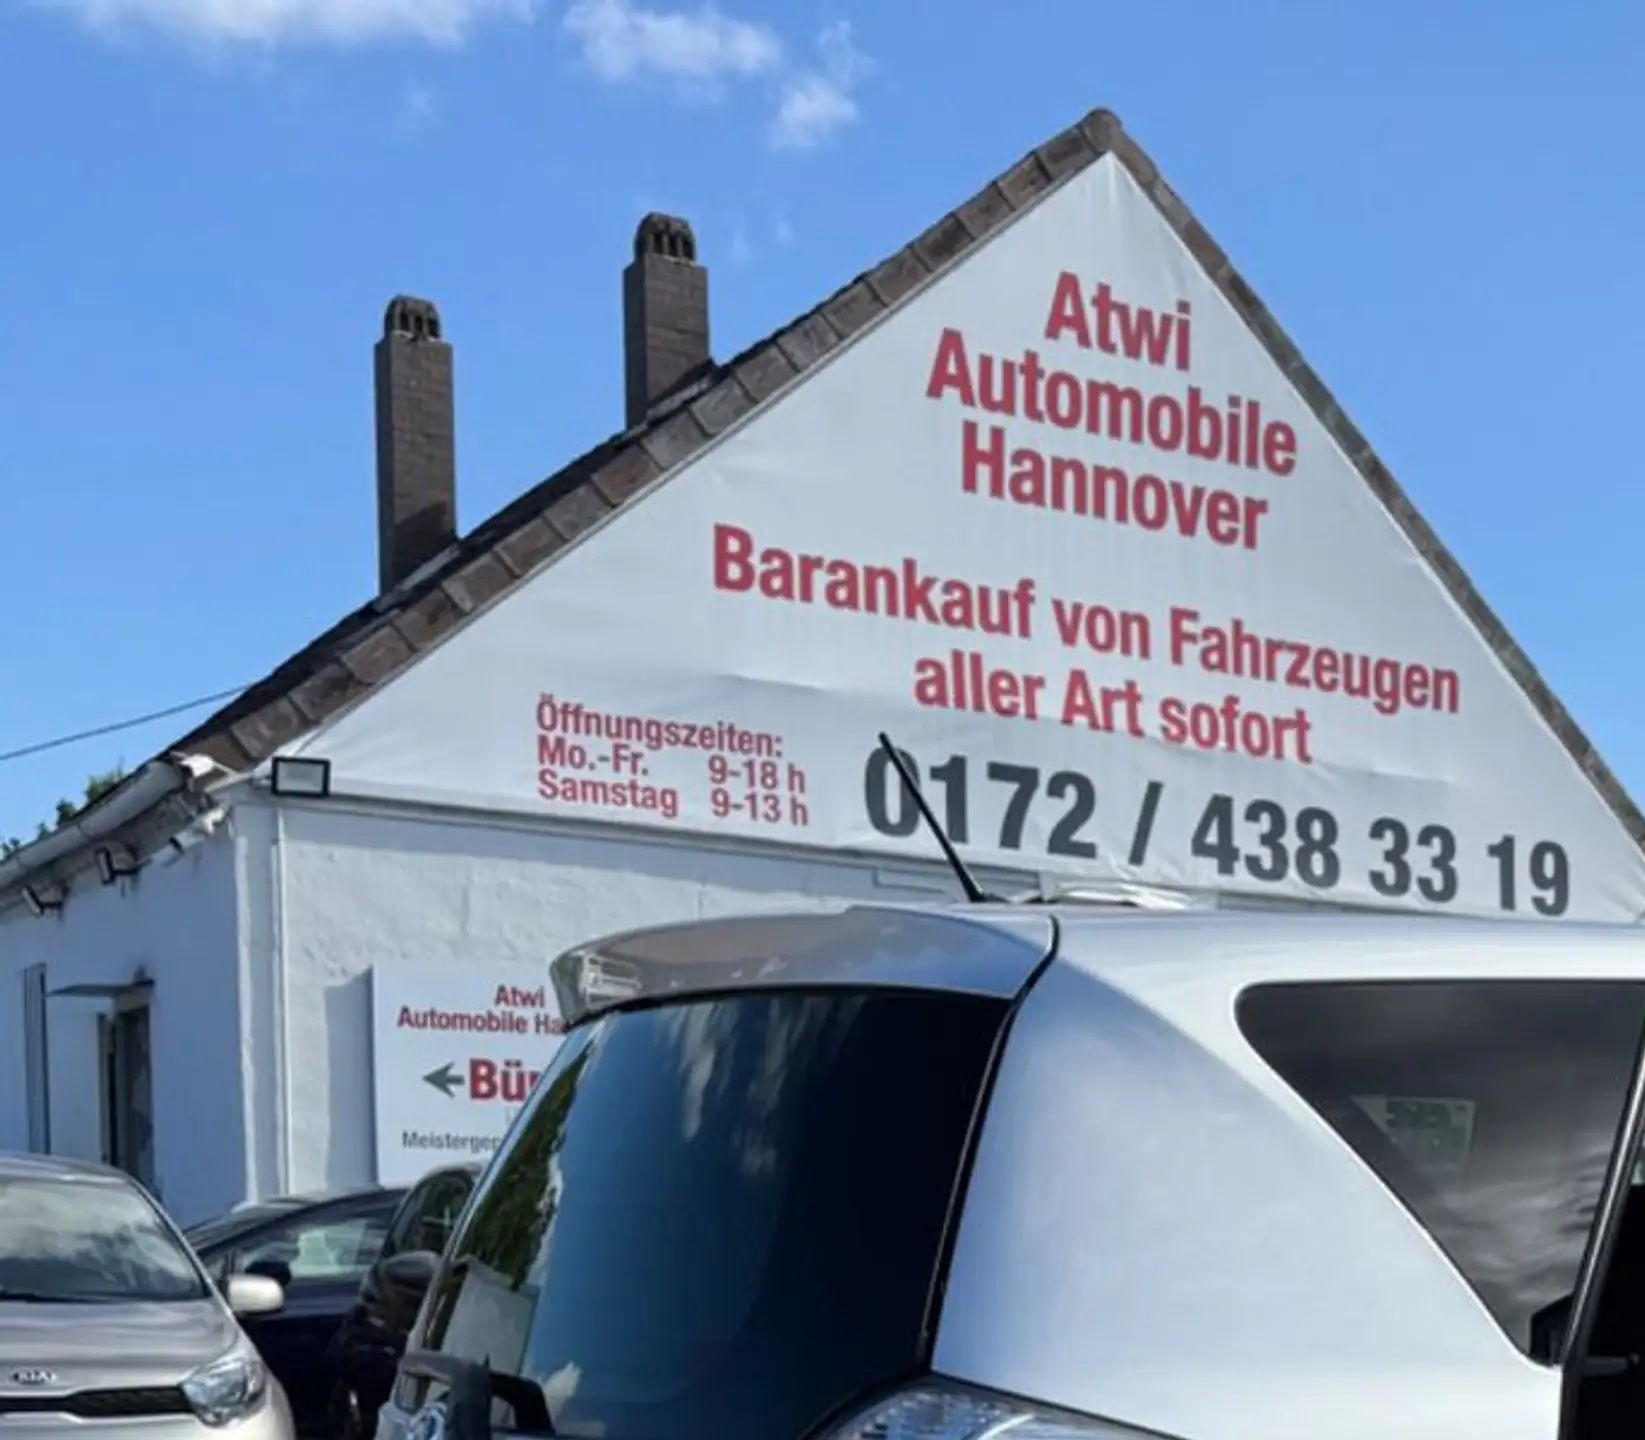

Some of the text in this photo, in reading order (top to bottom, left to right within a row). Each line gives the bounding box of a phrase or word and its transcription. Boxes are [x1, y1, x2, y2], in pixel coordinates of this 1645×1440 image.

[1044, 271, 1192, 371] Atwi
[926, 327, 1297, 477] Automobile
[961, 420, 1269, 550] Hannover
[713, 522, 1461, 715] Barankauf von Fahrzeugen
[536, 692, 783, 758] Öffnungszeiten:
[913, 648, 1313, 764] aller Art sofort
[537, 734, 806, 794] Mo.-Fr. 9-18 h
[537, 768, 809, 827] Samstag 9-13 h
[864, 745, 1570, 917] 0172 / 438 33 19
[397, 1005, 529, 1035] Automobile
[494, 985, 546, 1008] Atwi
